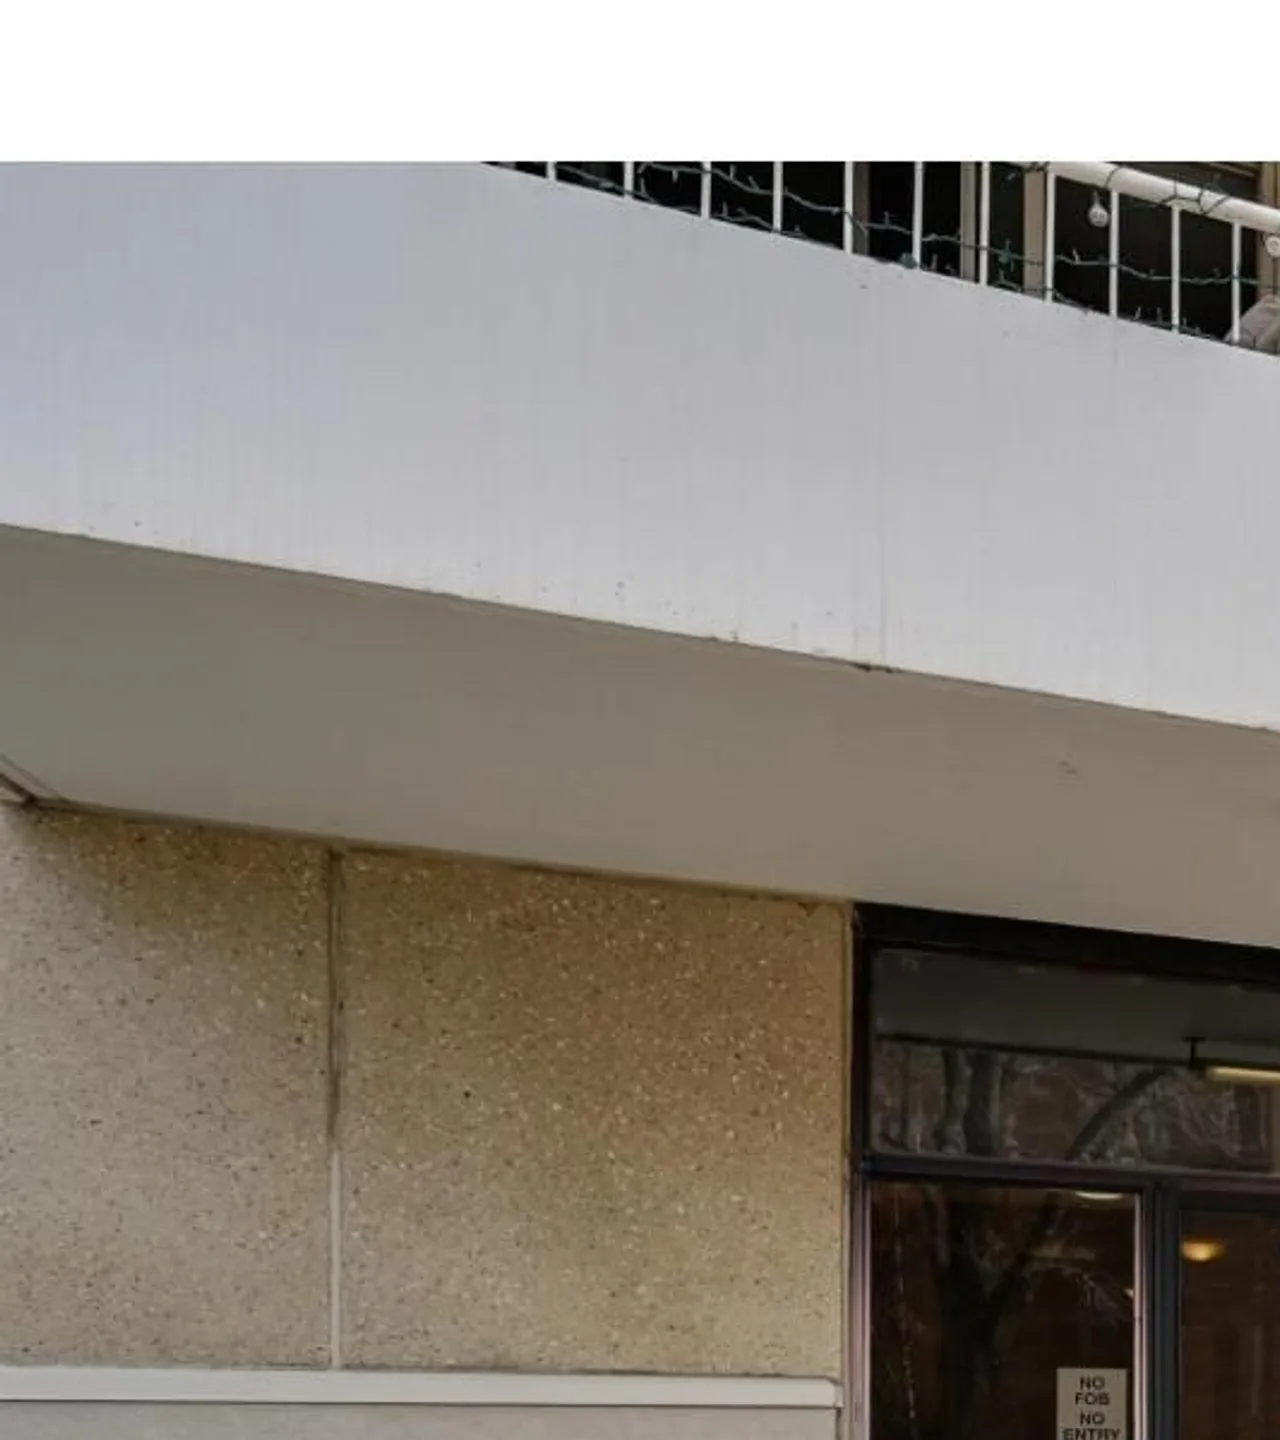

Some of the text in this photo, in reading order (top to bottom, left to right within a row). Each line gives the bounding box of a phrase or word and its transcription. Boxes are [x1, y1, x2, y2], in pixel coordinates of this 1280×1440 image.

[1080, 1375, 1105, 1390] NO
[1075, 1391, 1110, 1406] FOB
[1080, 1410, 1105, 1426] NO
